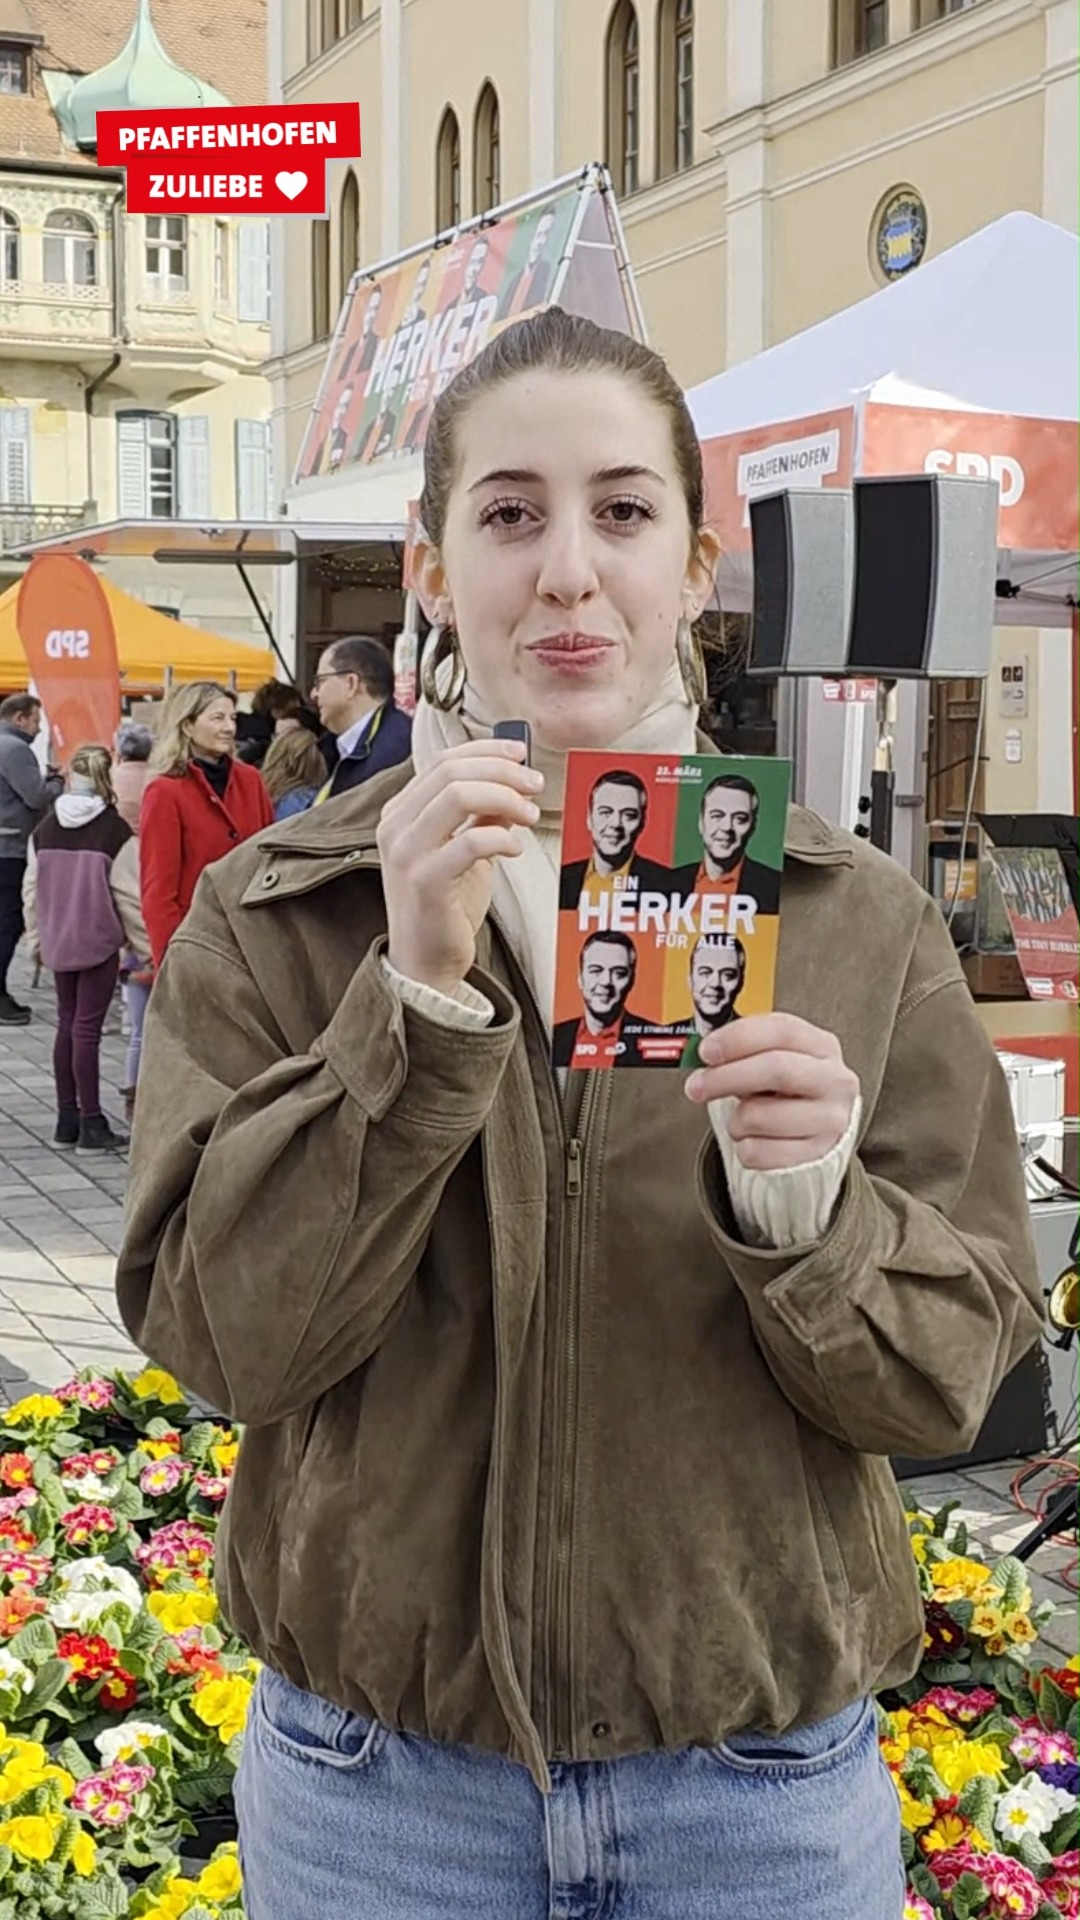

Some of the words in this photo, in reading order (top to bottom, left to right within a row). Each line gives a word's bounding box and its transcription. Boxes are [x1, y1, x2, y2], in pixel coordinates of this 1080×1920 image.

[363, 294, 499, 398] HERKER
[746, 446, 830, 482] PFAFFENHOFEN
[613, 875, 639, 890] EIN
[578, 891, 758, 934] HERKER
[655, 933, 688, 949] FÜR
[697, 936, 736, 950] ALLE
